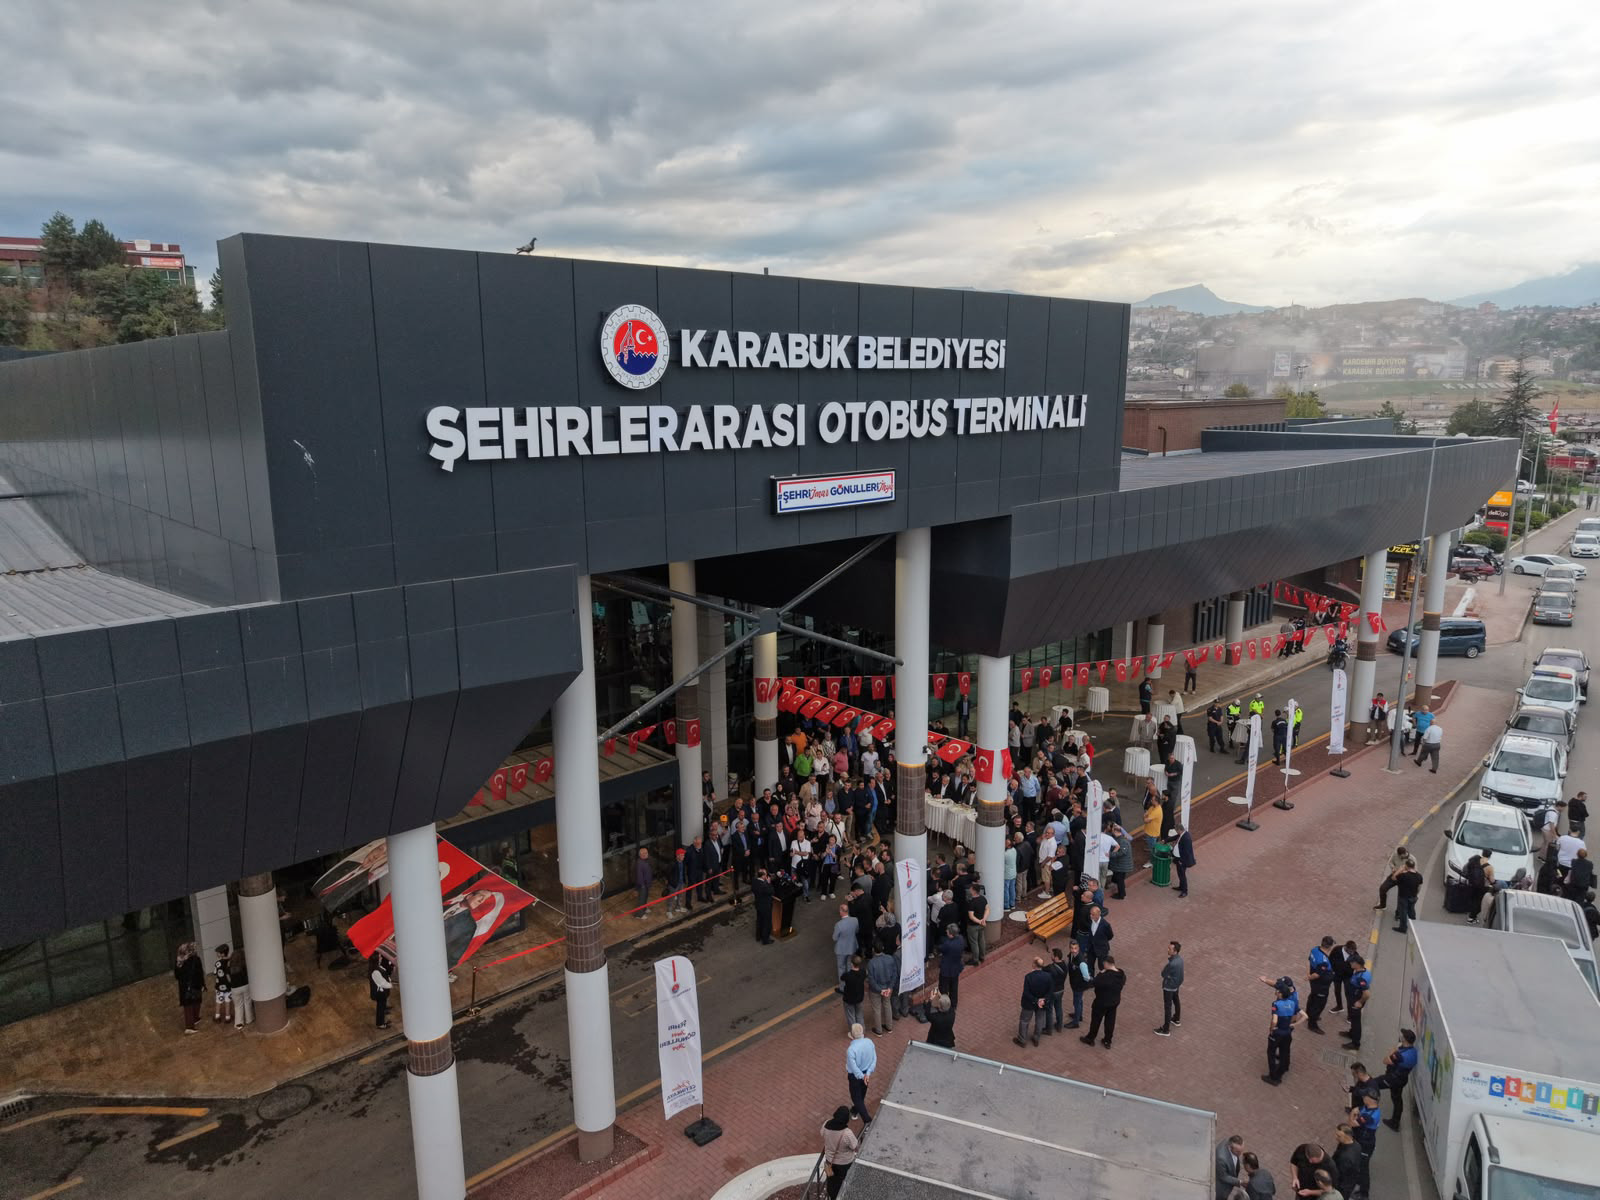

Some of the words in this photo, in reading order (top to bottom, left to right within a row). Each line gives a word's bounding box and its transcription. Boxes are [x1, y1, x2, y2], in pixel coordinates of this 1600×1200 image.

[681, 329, 852, 369] KARABÜK
[858, 335, 1006, 370] BELEDİYESİ
[426, 403, 805, 472] ŞEHİRLERARASI
[819, 398, 949, 444] OTOBÜS
[953, 394, 1088, 435] TERMİNALİ
[830, 482, 879, 496] GÖNÜLLERİ
